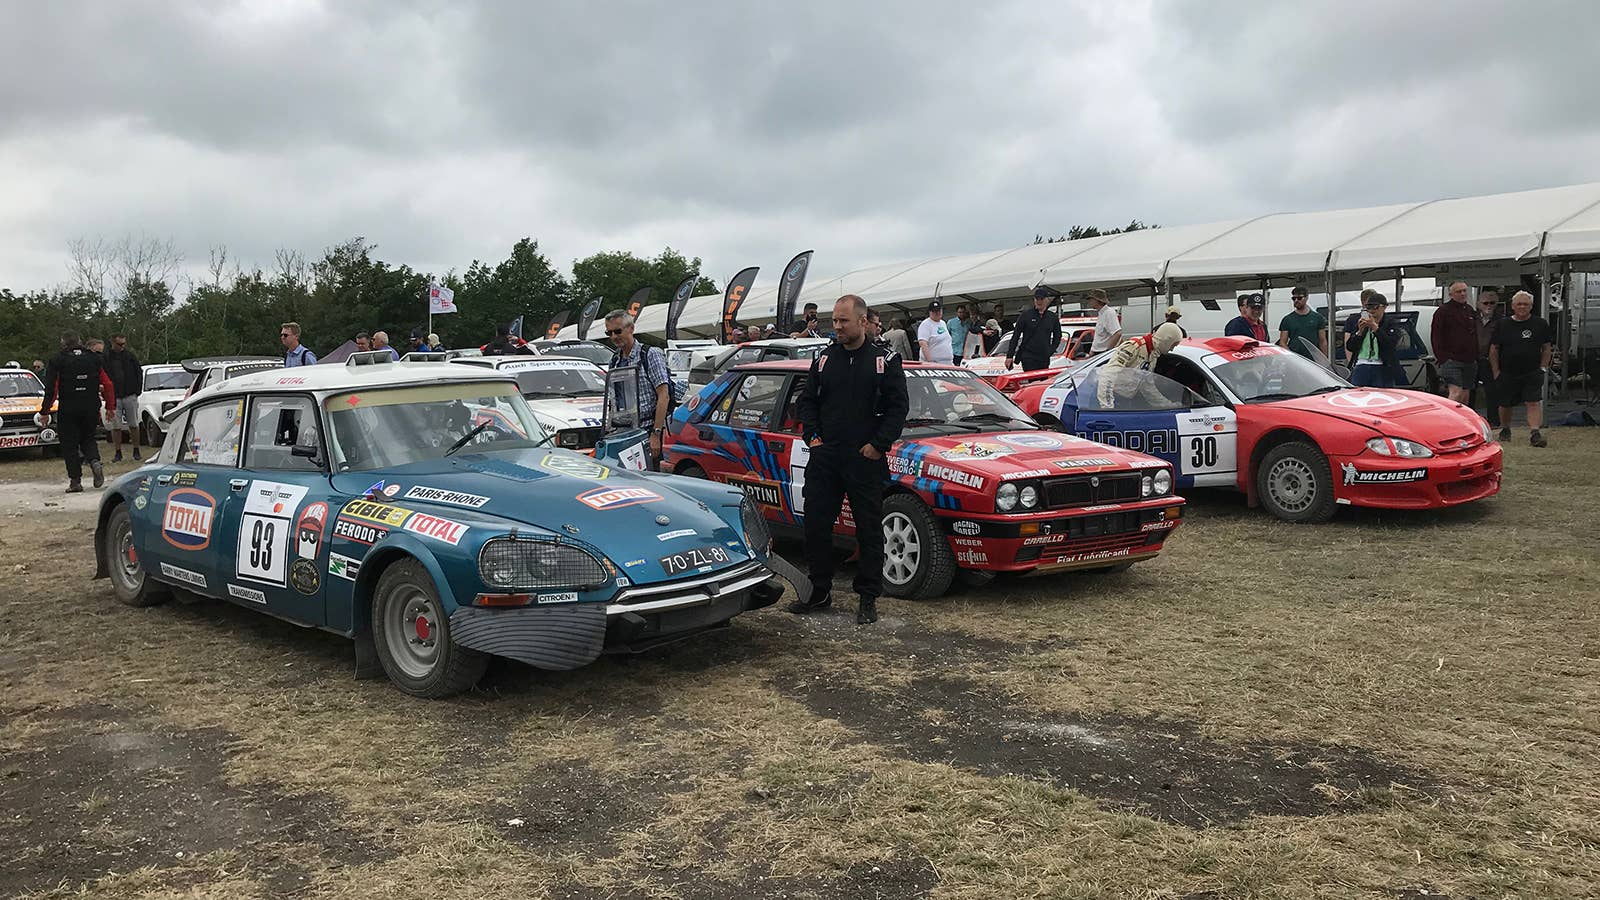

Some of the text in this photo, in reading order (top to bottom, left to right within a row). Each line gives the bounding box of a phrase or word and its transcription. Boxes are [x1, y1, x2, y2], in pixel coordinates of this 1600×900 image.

[504, 362, 526, 370] Audi
[914, 370, 972, 379] MARTINI
[0, 435, 39, 448] Castrol
[1191, 436, 1217, 468] 30
[1056, 457, 1115, 469] MARTINI
[1128, 460, 1168, 469] MICHELIN
[927, 464, 985, 489] MICHELIN
[1001, 468, 1051, 481] MICHELIN
[1359, 469, 1426, 481] MICHELIN
[408, 487, 486, 508] PARIS-RHONE
[587, 488, 656, 506] TOTAL
[345, 501, 394, 521] CIBIE
[168, 506, 211, 536] TOTAL
[335, 521, 376, 543] FERODO
[409, 513, 462, 543] TOTAL
[249, 519, 275, 571] 93
[954, 538, 983, 547] WEBER
[1023, 535, 1065, 546] CARELLO
[1057, 554, 1075, 564] Fiat
